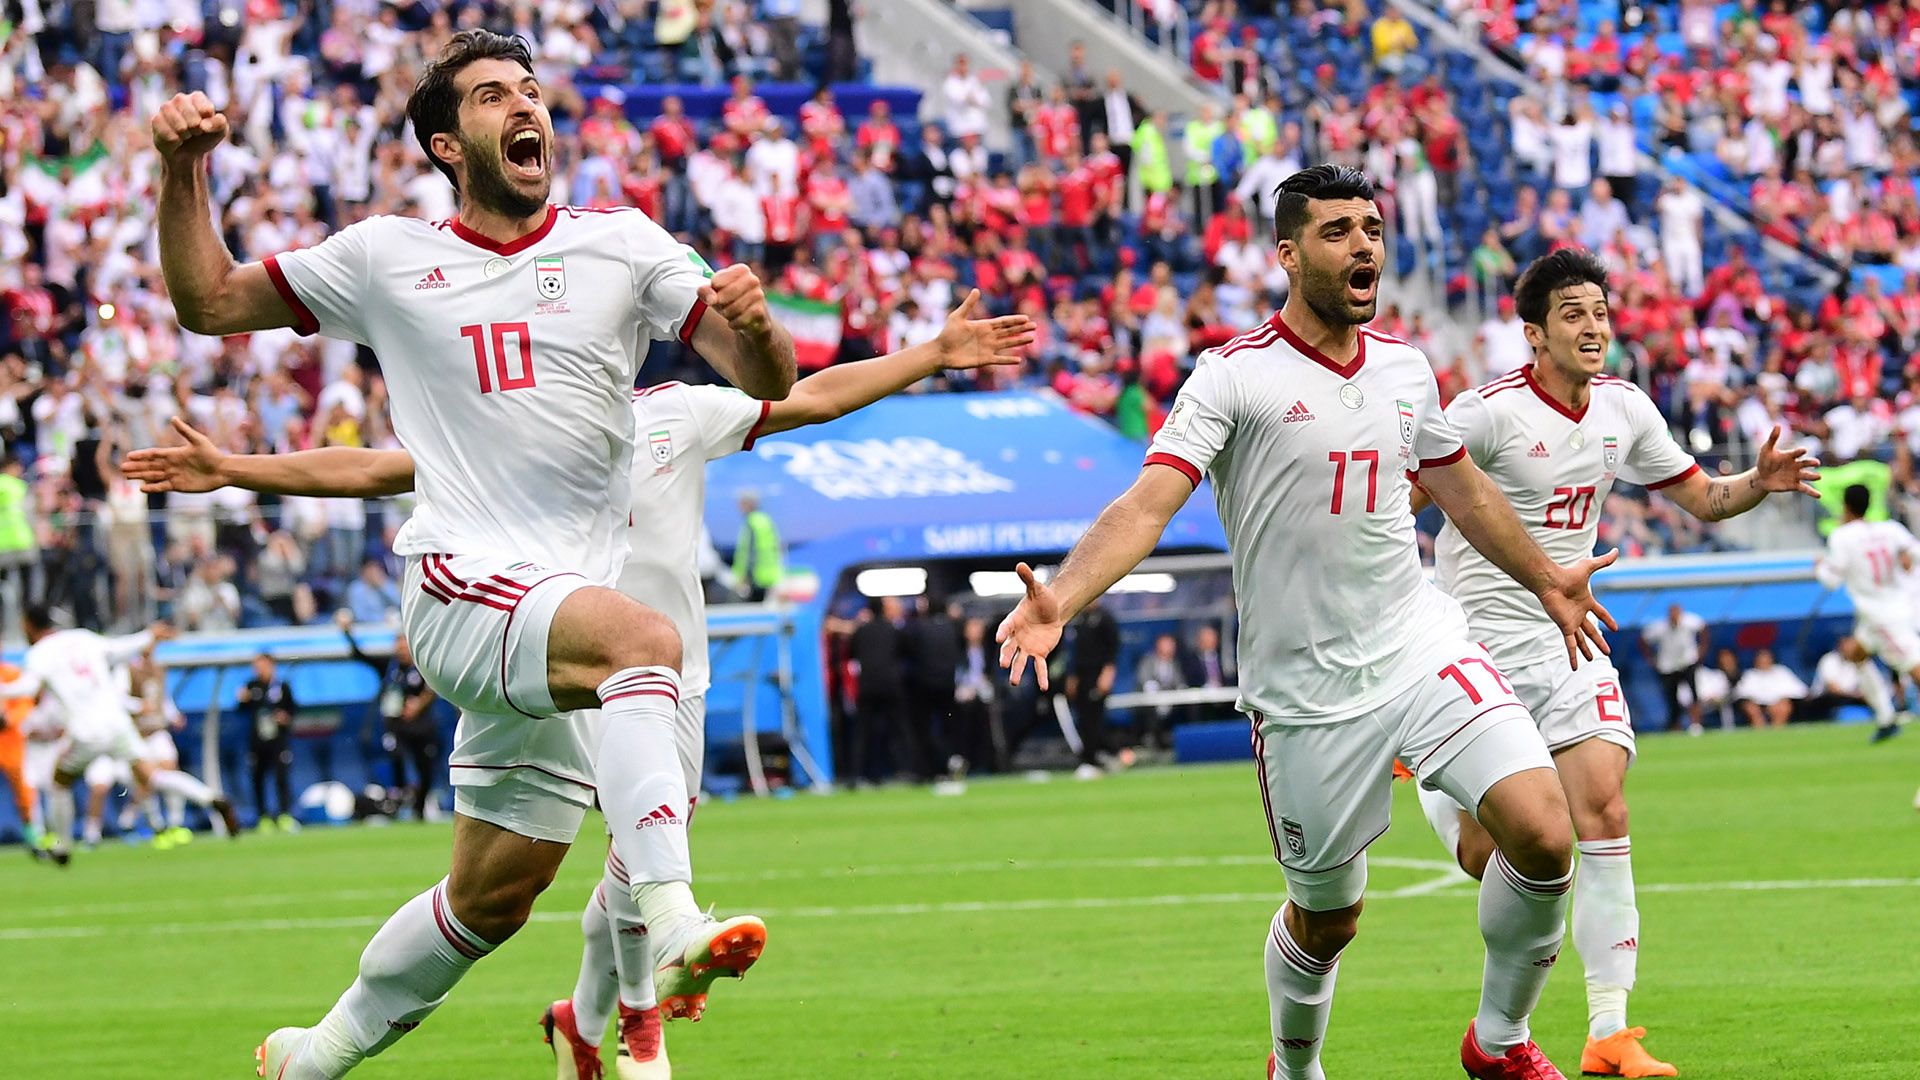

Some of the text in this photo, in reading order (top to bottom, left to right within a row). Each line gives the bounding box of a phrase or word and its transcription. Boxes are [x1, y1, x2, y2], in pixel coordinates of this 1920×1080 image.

[415, 282, 451, 290] adidas
[460, 321, 536, 394] 10
[1283, 413, 1315, 423] adidas
[1328, 449, 1379, 515] 17
[1542, 486, 1596, 530] 20
[1866, 547, 1893, 586] 11
[1437, 657, 1513, 706] 17
[635, 817, 683, 830] adidas
